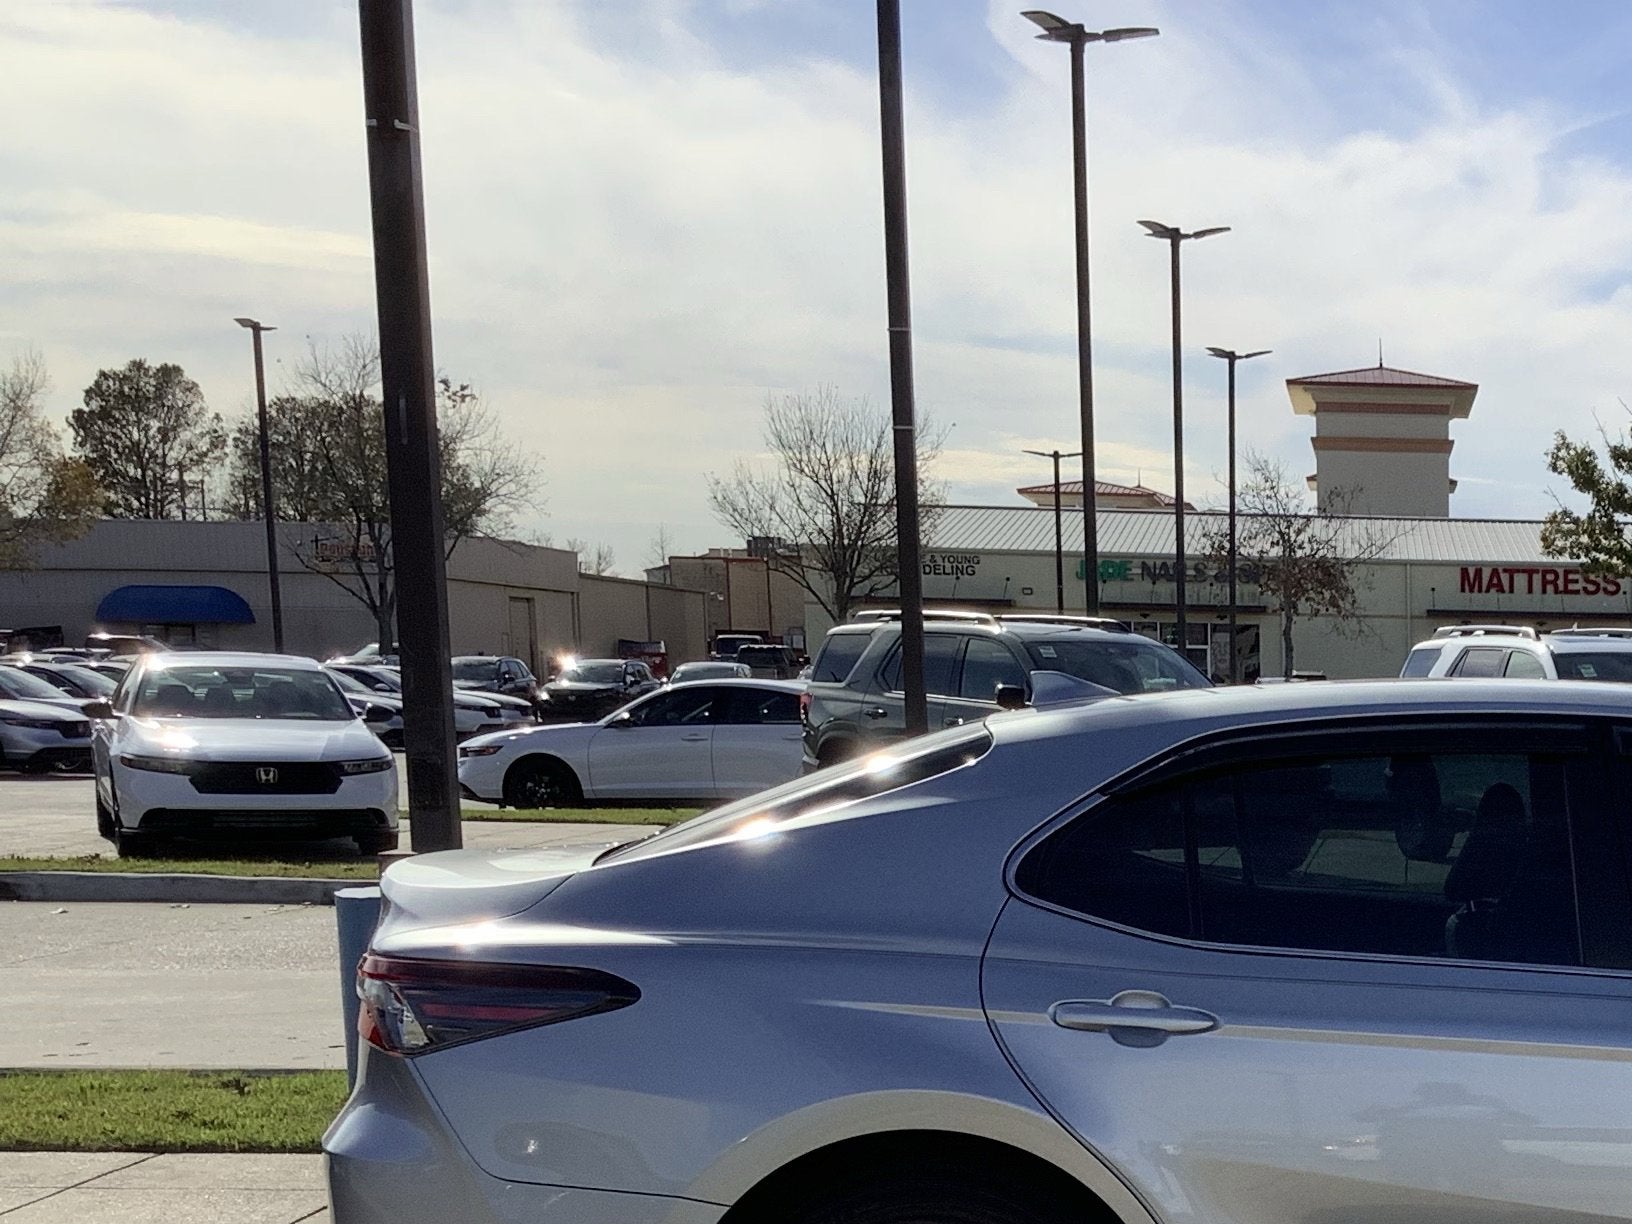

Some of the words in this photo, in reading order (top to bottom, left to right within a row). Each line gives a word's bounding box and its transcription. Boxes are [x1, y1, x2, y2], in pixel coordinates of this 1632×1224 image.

[930, 554, 938, 564] &
[940, 554, 980, 565] YOUNG
[921, 564, 976, 576] DELING
[1076, 559, 1135, 581] JDE
[1459, 566, 1622, 596] MATTRESS
